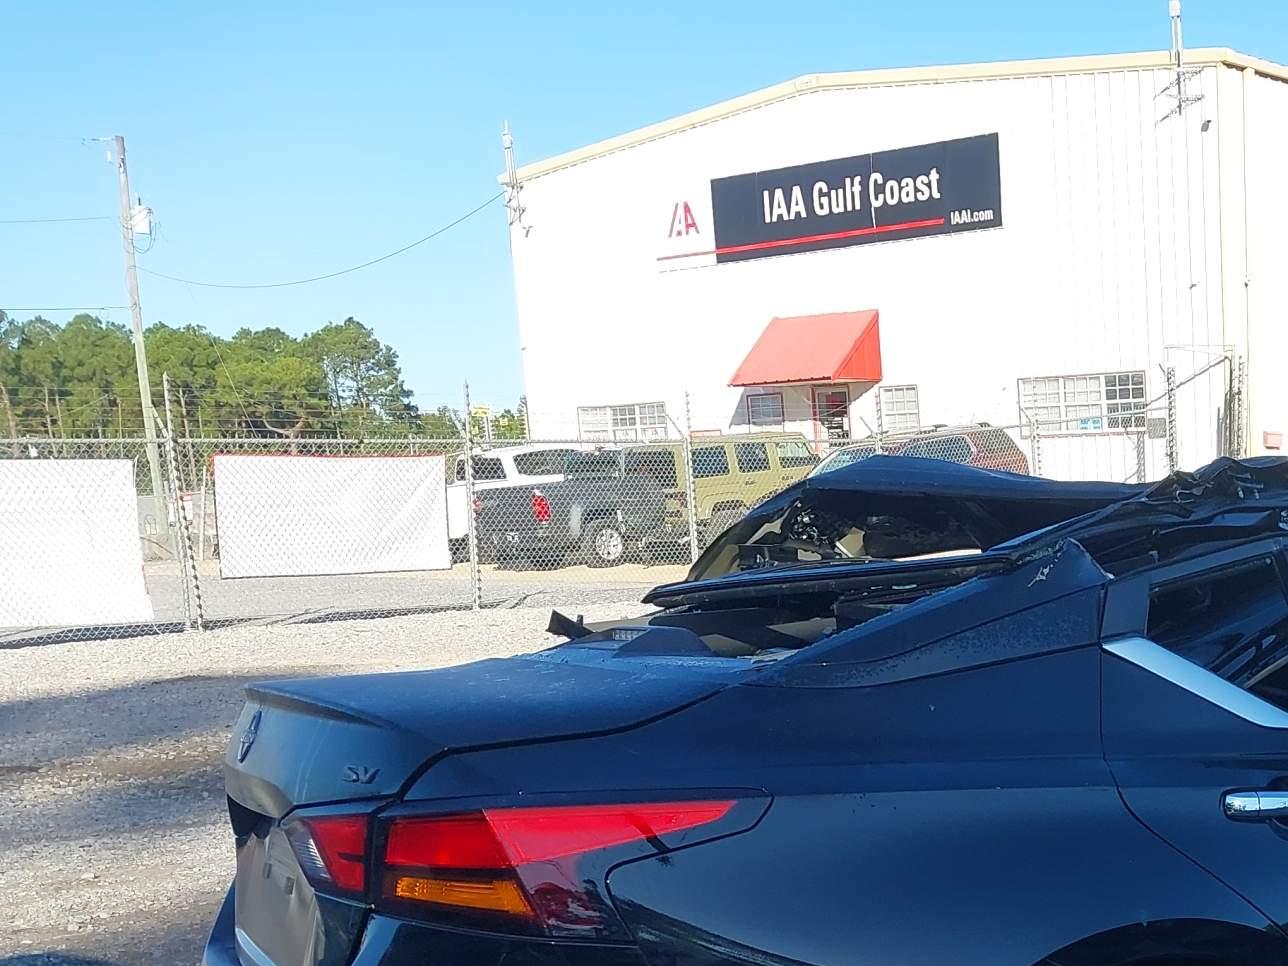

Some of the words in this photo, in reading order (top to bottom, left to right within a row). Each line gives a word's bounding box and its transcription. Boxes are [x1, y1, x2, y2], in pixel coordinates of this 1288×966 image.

[763, 186, 806, 223] IAA
[813, 175, 862, 216] Gulf
[868, 167, 941, 209] Coast
[342, 765, 380, 785] SV
